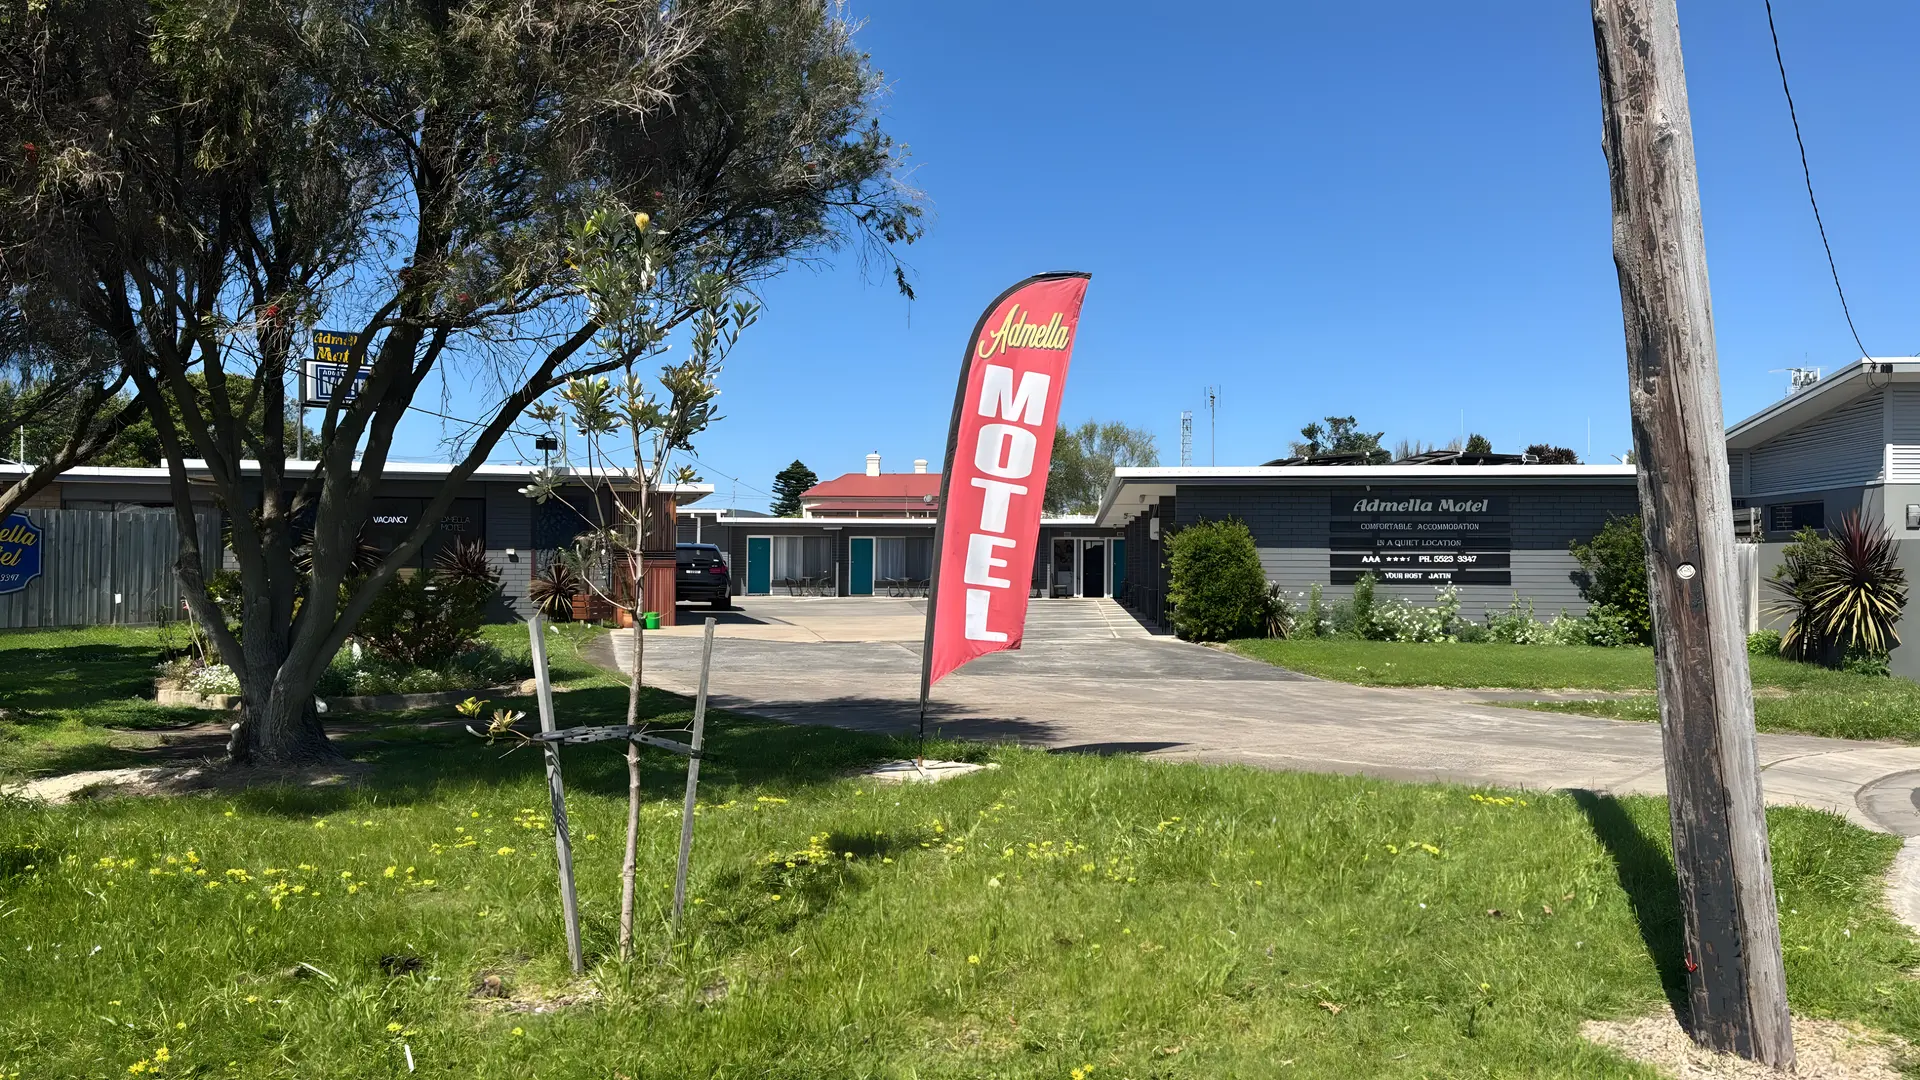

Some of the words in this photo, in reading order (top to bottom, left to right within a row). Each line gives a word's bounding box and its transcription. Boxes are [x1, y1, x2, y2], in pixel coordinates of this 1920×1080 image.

[978, 303, 1070, 359] Admella
[963, 363, 1051, 643] MOTEL
[1353, 499, 1432, 512] Admella
[1438, 499, 1488, 512] Motel
[372, 516, 409, 524] VACANCY
[1361, 555, 1381, 563] AAA
[1433, 555, 1454, 563] 5523
[1457, 555, 1477, 563] 3347
